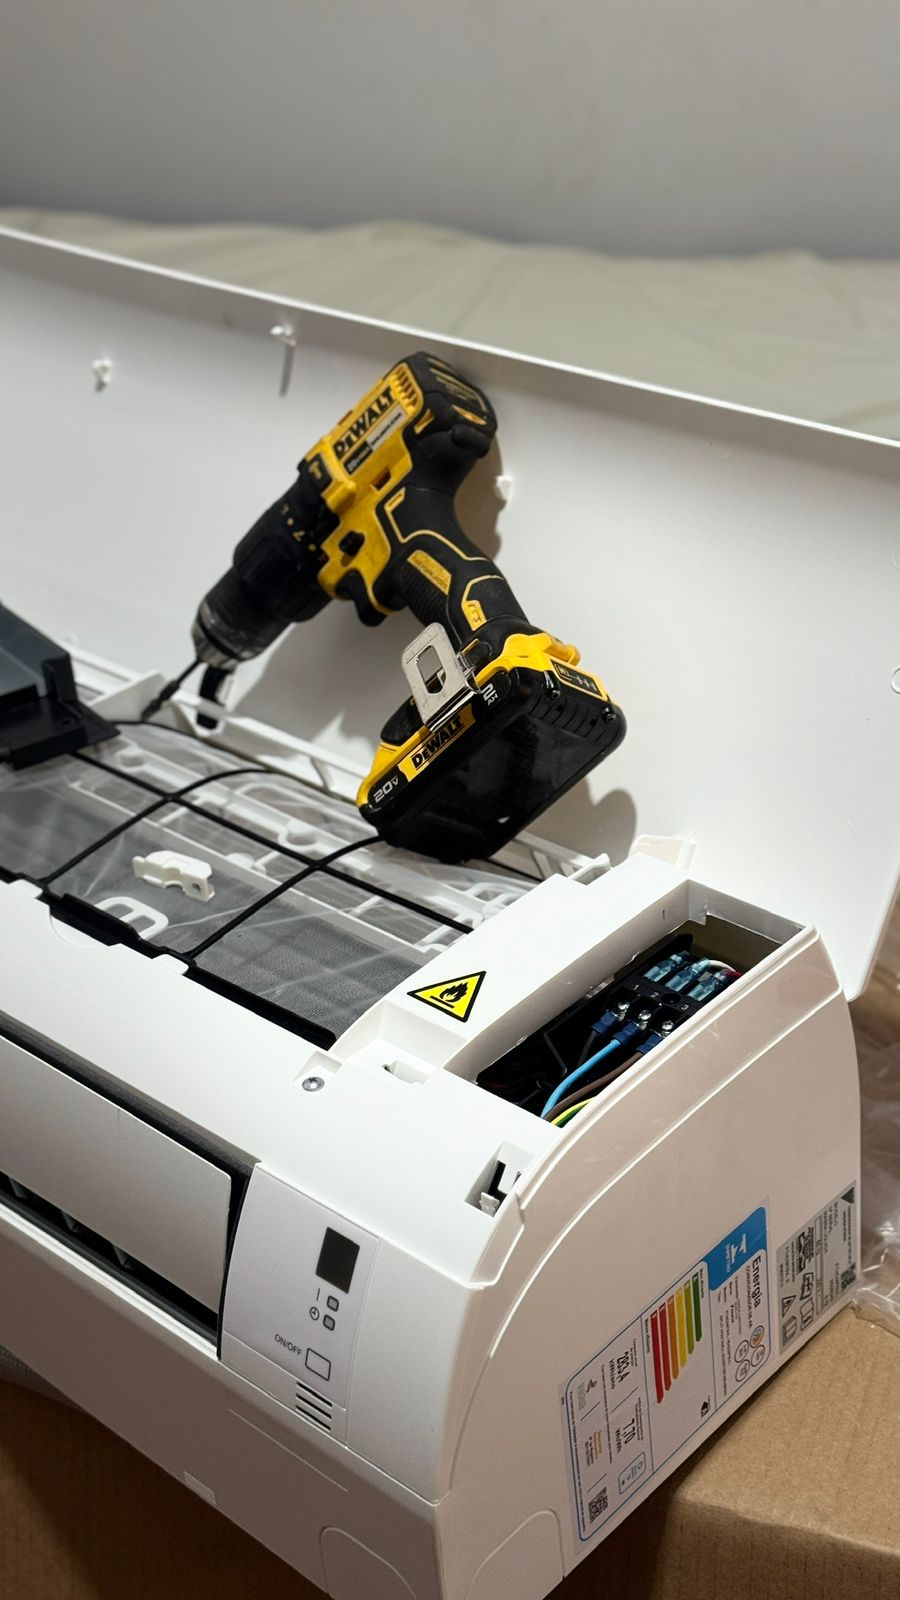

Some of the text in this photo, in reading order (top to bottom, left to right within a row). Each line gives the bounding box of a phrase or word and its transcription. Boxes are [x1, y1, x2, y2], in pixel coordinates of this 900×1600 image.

[333, 387, 394, 459] DEWALT
[412, 713, 464, 769] DEWALT
[373, 777, 398, 803] 20V
[750, 1254, 762, 1310] Energia
[274, 1333, 303, 1356] ON/OFF
[614, 1349, 630, 1385] 283,4
[621, 1417, 635, 1447] 7,70
